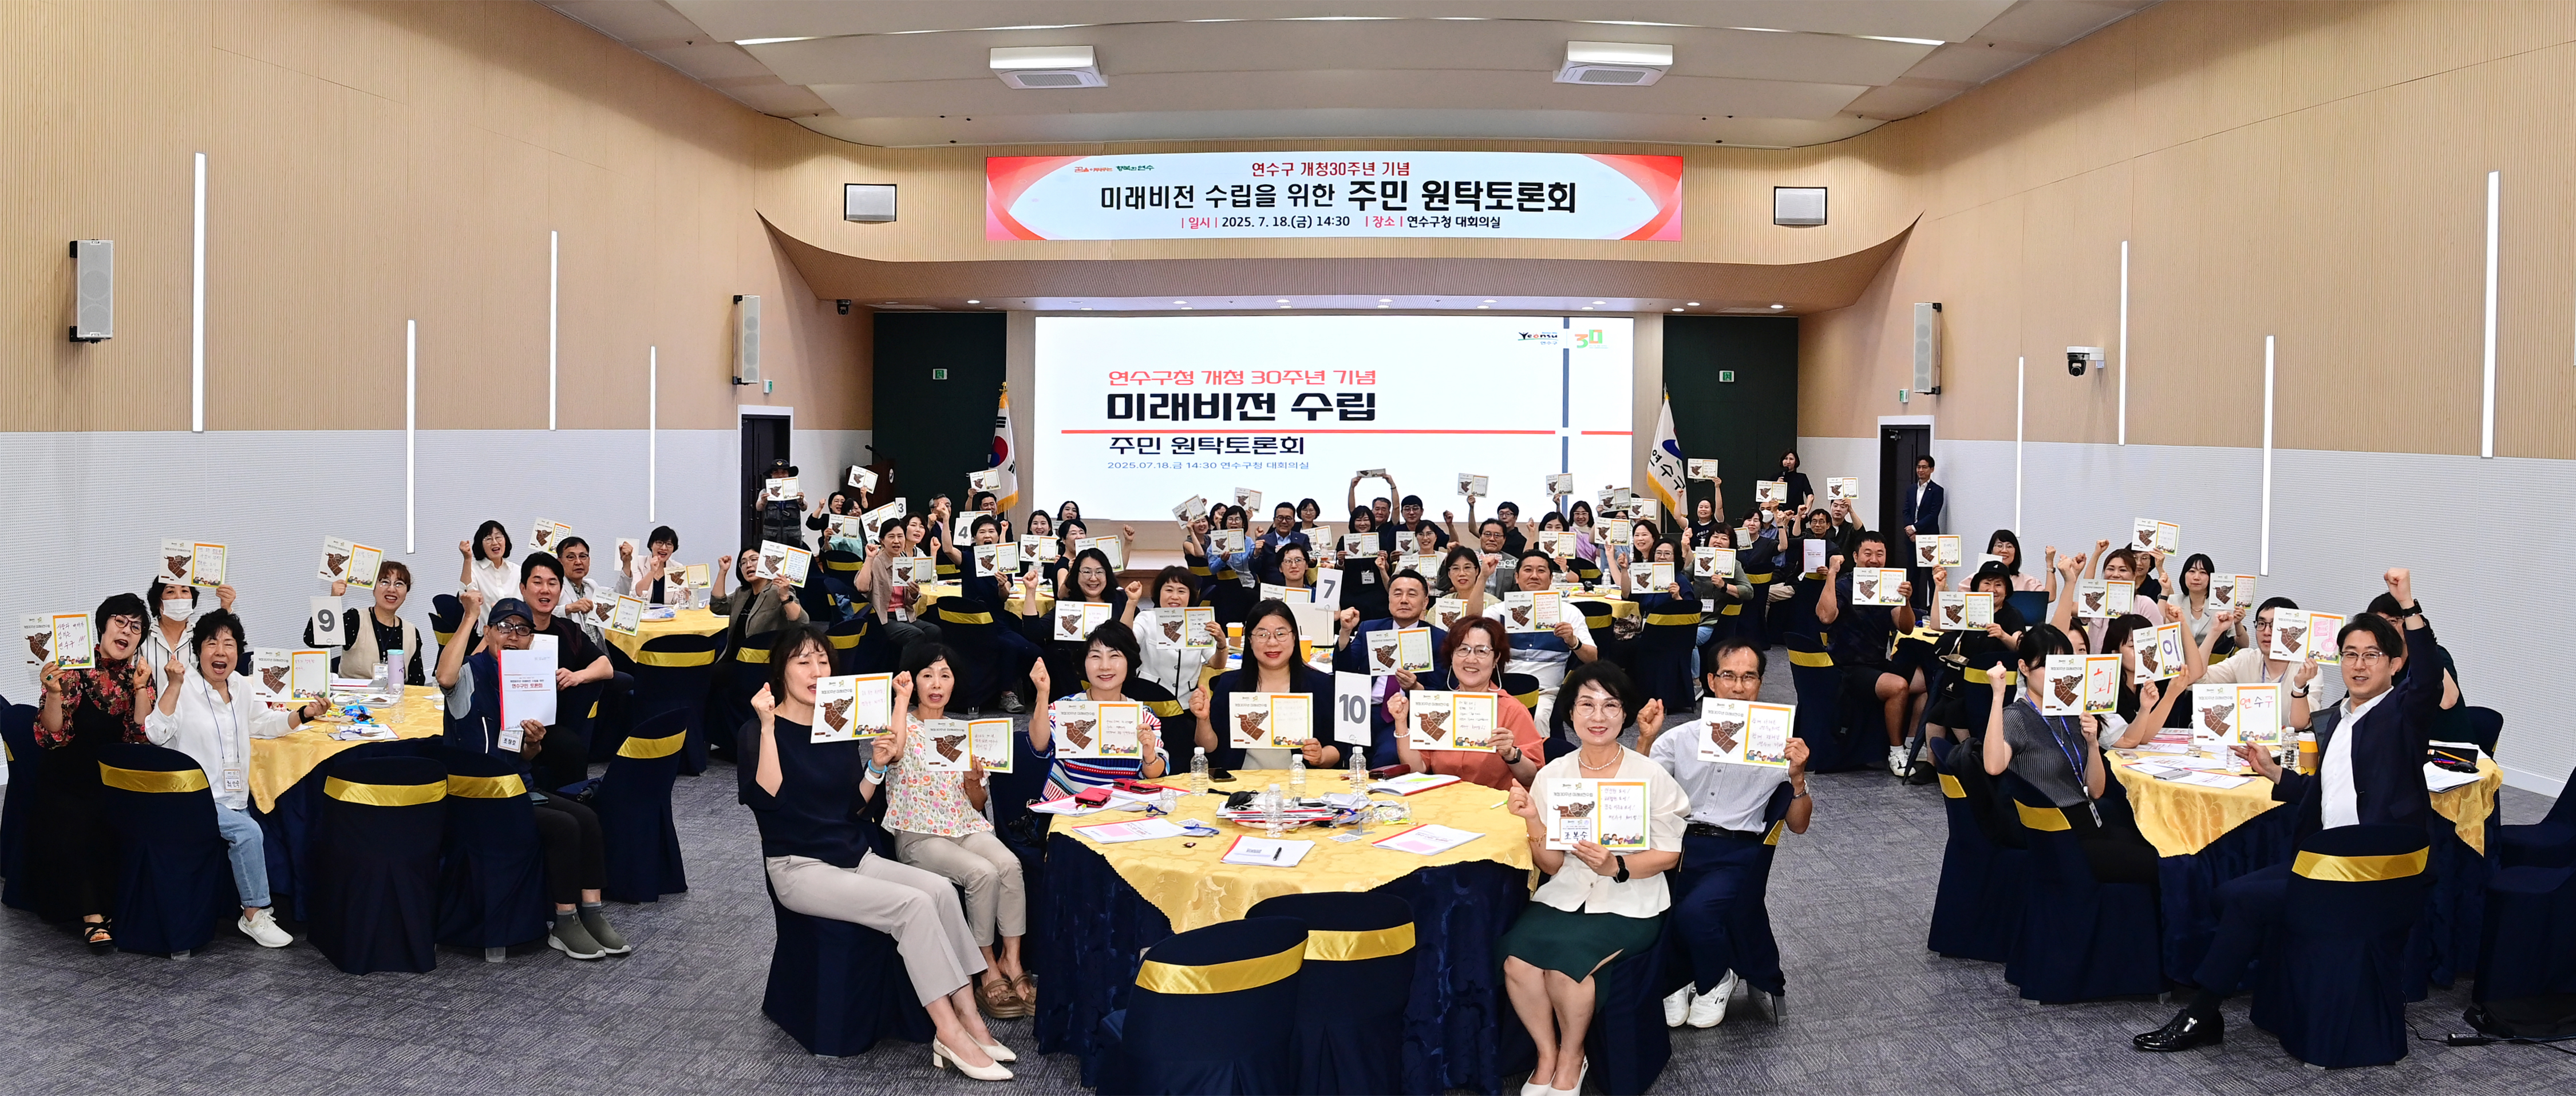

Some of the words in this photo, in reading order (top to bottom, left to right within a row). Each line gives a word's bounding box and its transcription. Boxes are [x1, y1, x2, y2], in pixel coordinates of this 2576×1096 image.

[1251, 162, 1294, 176] 연수구
[1300, 161, 1375, 177] 개청30주년
[1382, 161, 1410, 176] 기념
[1101, 185, 1194, 211] 미래비전
[1205, 184, 1277, 209] 수립을
[1287, 183, 1336, 208] 위한
[1348, 180, 1408, 212] 주민
[1421, 180, 1576, 213] 원탁토론회
[1188, 217, 1210, 230] 일시
[1222, 216, 1254, 228] 2025.
[1258, 217, 1269, 228] 7.
[1273, 215, 1313, 229] 18.(금)
[1316, 216, 1350, 227] 14:30
[1372, 216, 1396, 228] 장소
[1406, 215, 1452, 229] 연수구청
[1455, 215, 1500, 229] 대회의실
[1574, 329, 1603, 349] 30
[1109, 370, 1194, 386] 연수구청
[1201, 369, 1244, 385] 개청
[1251, 370, 1325, 385] 30주년
[1333, 370, 1376, 385] 기념
[1107, 392, 1276, 422] 미래비전
[1290, 392, 1376, 422] 수립
[1109, 437, 1161, 455] 주민
[1171, 436, 1304, 455] 원탁토론회
[1650, 449, 1685, 490] 연수구
[898, 503, 904, 513] 3
[958, 526, 968, 539] 4
[1323, 579, 1336, 599] 7
[317, 609, 335, 632] 9
[58, 641, 74, 650] 연수구
[1338, 694, 1366, 725] 10
[2239, 696, 2274, 709] 연수구
